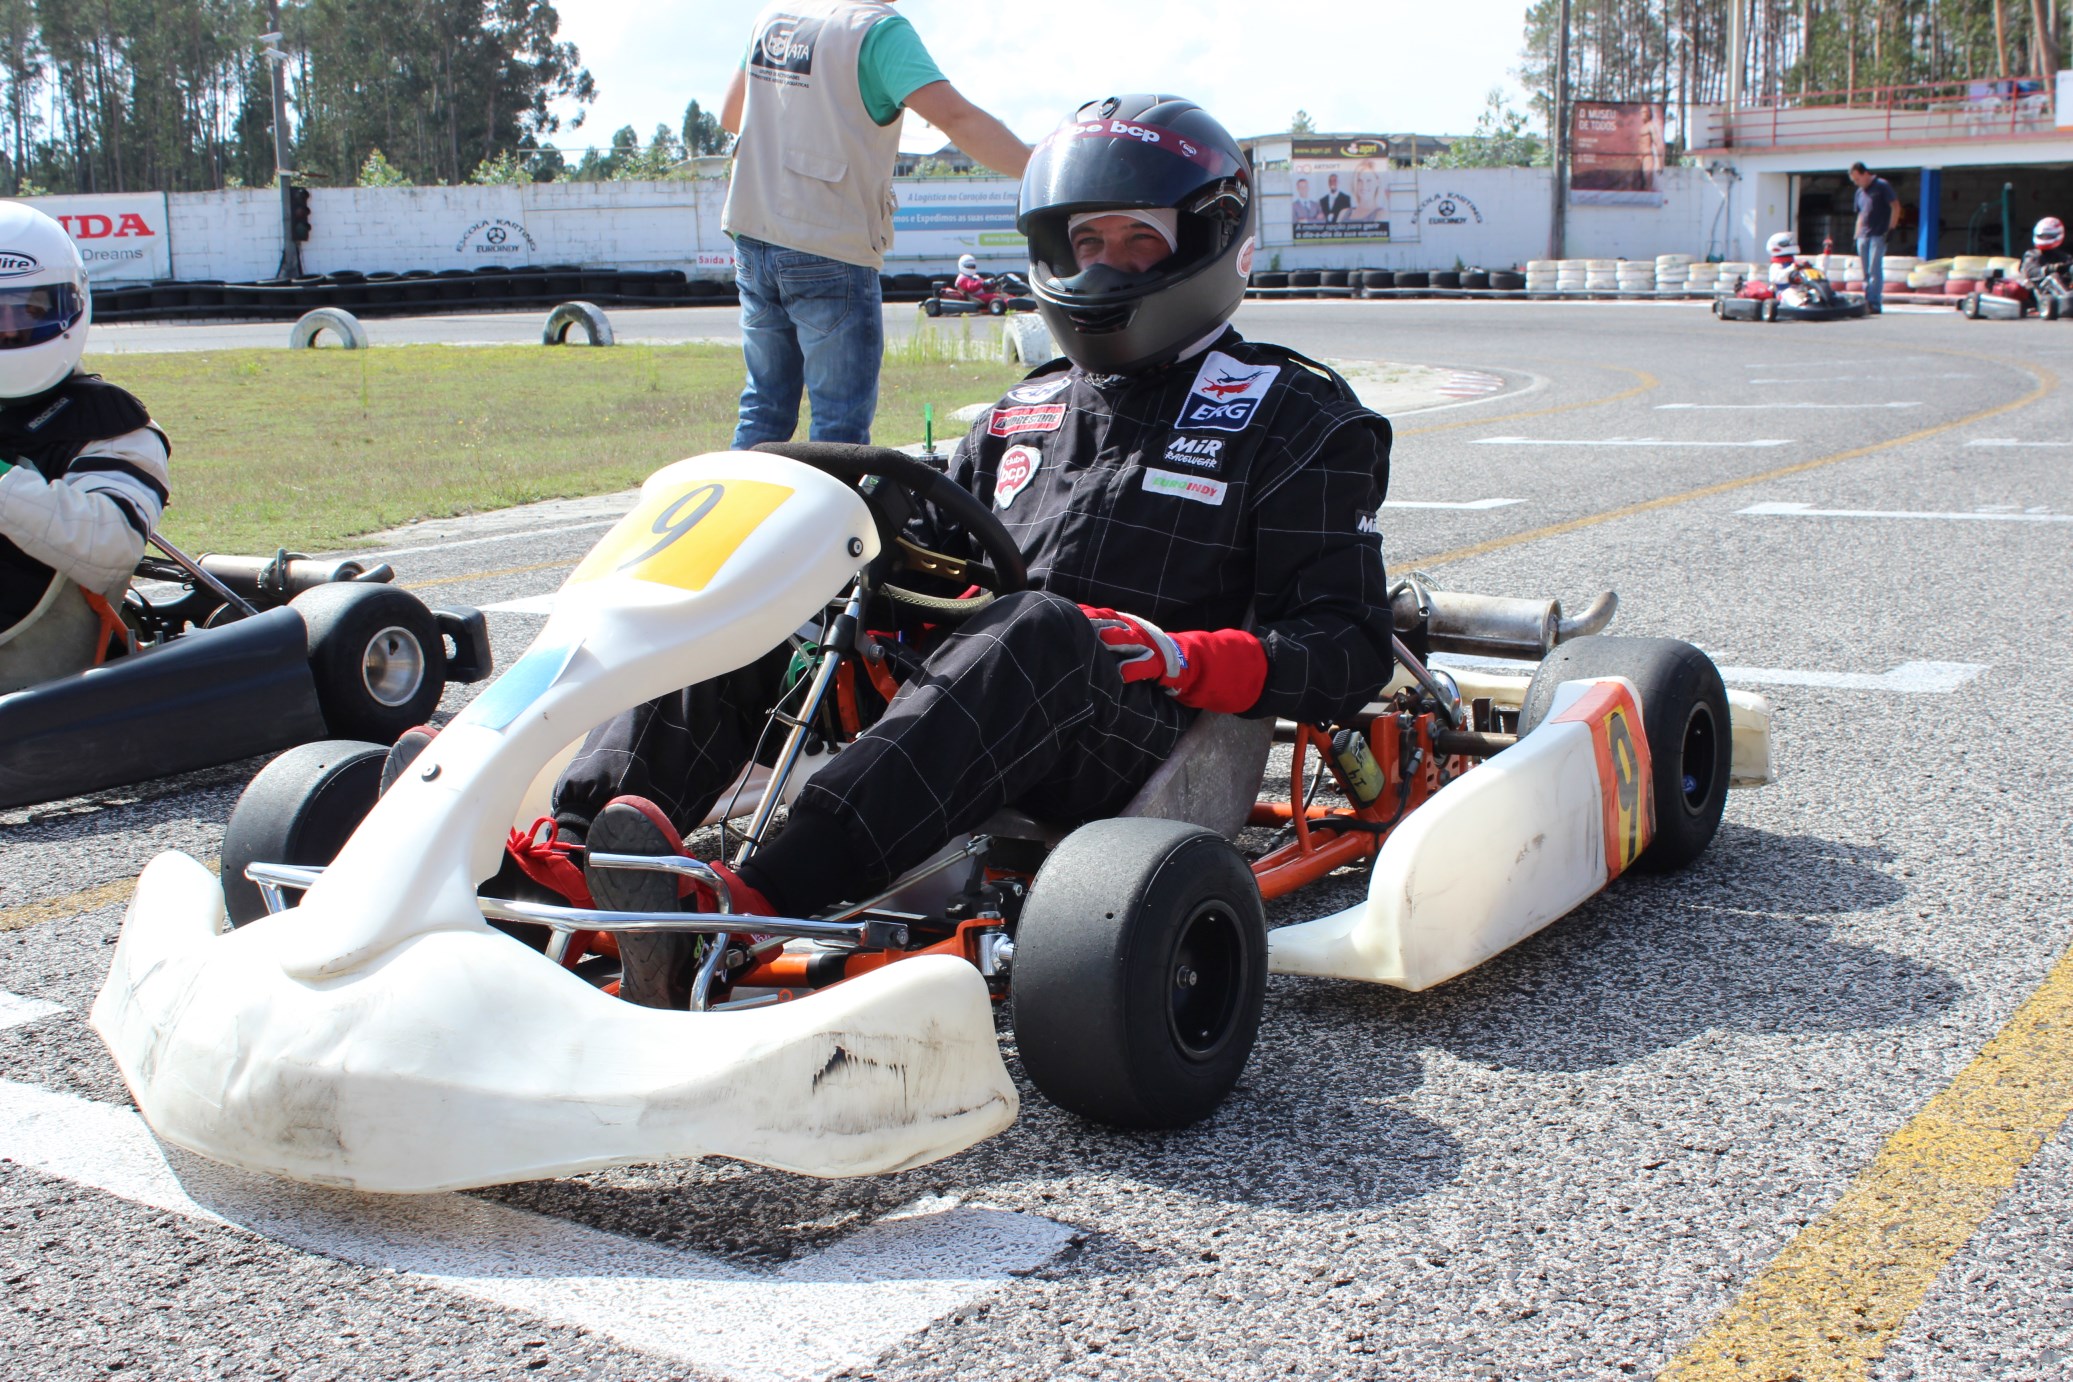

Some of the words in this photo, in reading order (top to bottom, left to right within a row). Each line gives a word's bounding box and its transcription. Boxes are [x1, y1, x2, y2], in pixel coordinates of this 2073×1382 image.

[1110, 120, 1160, 142] bcp
[82, 248, 143, 261] Dreams
[1005, 455, 1025, 466] clube
[1000, 466, 1026, 482] bcp
[1152, 477, 1217, 496] EUROINDY
[617, 484, 725, 571] 9
[1610, 712, 1639, 864] 9
